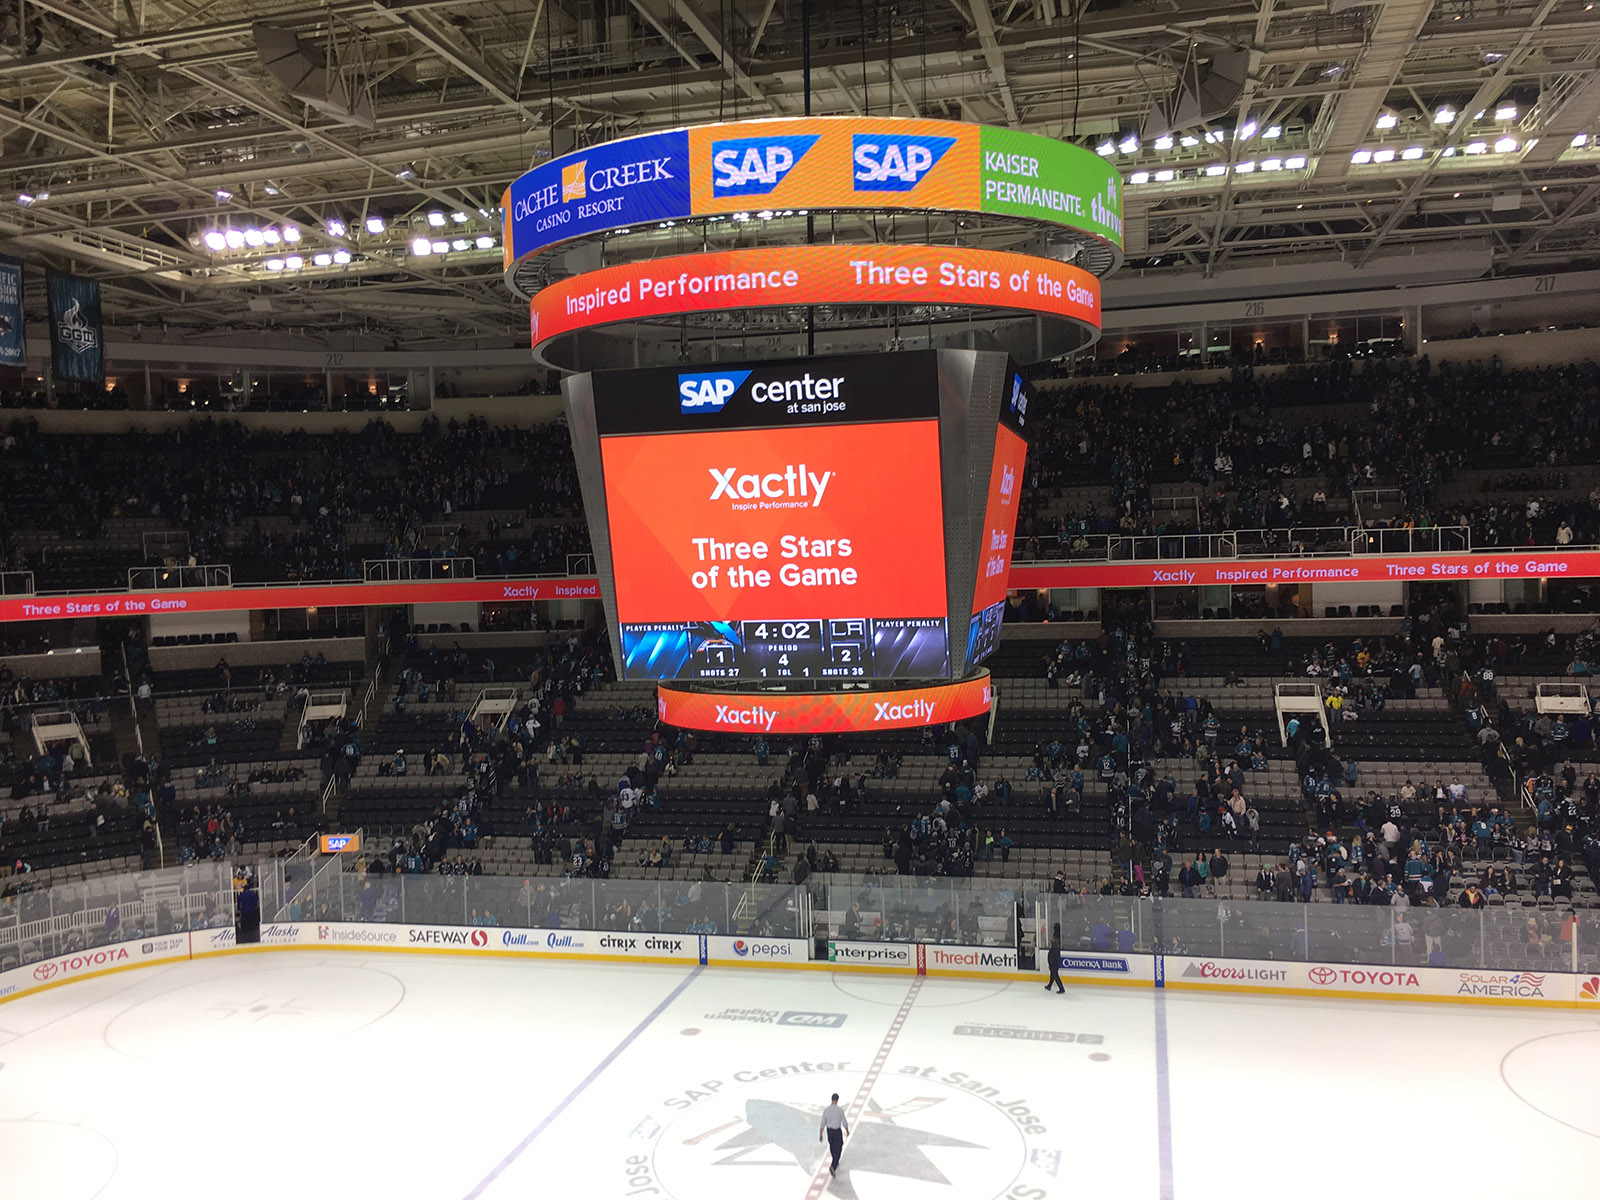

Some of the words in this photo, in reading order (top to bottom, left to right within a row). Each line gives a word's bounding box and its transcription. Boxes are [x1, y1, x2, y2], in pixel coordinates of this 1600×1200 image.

[714, 146, 794, 188] SAP
[854, 143, 933, 182] SAP
[985, 151, 1039, 178] KAISER
[515, 183, 559, 222] CACHE
[589, 157, 675, 193] CREEK
[985, 180, 1083, 217] PERMANENTE
[536, 210, 571, 232] CASINO
[578, 197, 624, 219] RESORT
[850, 260, 928, 285] Three
[939, 262, 1000, 290] Stars
[1009, 271, 1029, 293] of
[1037, 275, 1062, 298] the
[1066, 279, 1094, 309] Game
[1535, 277, 1555, 292] 217
[566, 281, 631, 316] Inspired
[639, 270, 799, 300] Performance
[1244, 302, 1264, 317] 216
[326, 353, 344, 366] 212
[679, 379, 735, 407] SAP
[751, 373, 845, 403] center
[787, 403, 799, 414] at
[801, 403, 820, 413] san
[821, 401, 846, 415] jose
[708, 464, 831, 507] Xactly
[732, 502, 758, 511] Inspire
[759, 500, 810, 510] Performance
[692, 537, 768, 561] Three
[780, 535, 852, 558] Stars
[1152, 569, 1195, 584] Xactly
[1215, 568, 1268, 581] Inspired
[1272, 566, 1359, 579] Performance
[1386, 564, 1425, 576] Three
[1431, 562, 1468, 575] Stars
[1474, 561, 1490, 573] of
[1495, 561, 1519, 573] the
[1525, 560, 1568, 573] Game
[692, 566, 719, 589] of
[727, 565, 771, 588] the
[780, 564, 857, 586] Game
[503, 586, 539, 599] Xactly
[555, 585, 596, 596] Inspired
[22, 604, 61, 616] Three
[66, 602, 101, 613] Stars
[106, 600, 121, 611] of
[125, 599, 146, 611] the
[150, 598, 187, 609] Game
[653, 624, 684, 632] PENALTY
[754, 623, 810, 640] 4:02
[831, 622, 863, 636] LA
[716, 650, 724, 663] 1
[778, 653, 789, 666] 4
[840, 650, 851, 662] 2
[728, 668, 740, 677] 27
[760, 667, 767, 677] 1
[802, 667, 809, 677] 1
[822, 668, 849, 676] SHOTS
[1482, 671, 1494, 681] 88
[715, 705, 777, 729] Xactly
[874, 699, 935, 722] Xactly
[1102, 762, 1111, 770] 12
[1390, 808, 1401, 818] 39
[328, 839, 347, 849] SAP
[261, 925, 299, 937] Alaska
[332, 929, 397, 943] InsideSource
[409, 930, 469, 944] SAFEWAY
[502, 930, 539, 946] Quill.com
[547, 932, 585, 948] Quill.com
[751, 943, 791, 957] pepsi
[60, 947, 129, 973] TOYOTA
[1102, 960, 1123, 969] Bank
[1155, 955, 1163, 981] Reebok
[1200, 961, 1246, 980] Coors
[1247, 969, 1287, 981] LIGHT
[1340, 970, 1420, 986] TOYOTA
[1459, 973, 1508, 984] SOLAR
[1509, 974, 1520, 984] 4
[1457, 983, 1544, 997] AMERICA
[703, 1013, 774, 1024] Western
[724, 1008, 780, 1018] Digital
[786, 1014, 838, 1025] WD
[959, 1026, 1070, 1042] CHIPOTLE
[663, 1079, 724, 1110] SAP
[733, 1061, 852, 1083] Center
[898, 1065, 937, 1078] at
[941, 1072, 1000, 1098] San
[995, 1099, 1048, 1135] Jose
[625, 1154, 660, 1197] Jose
